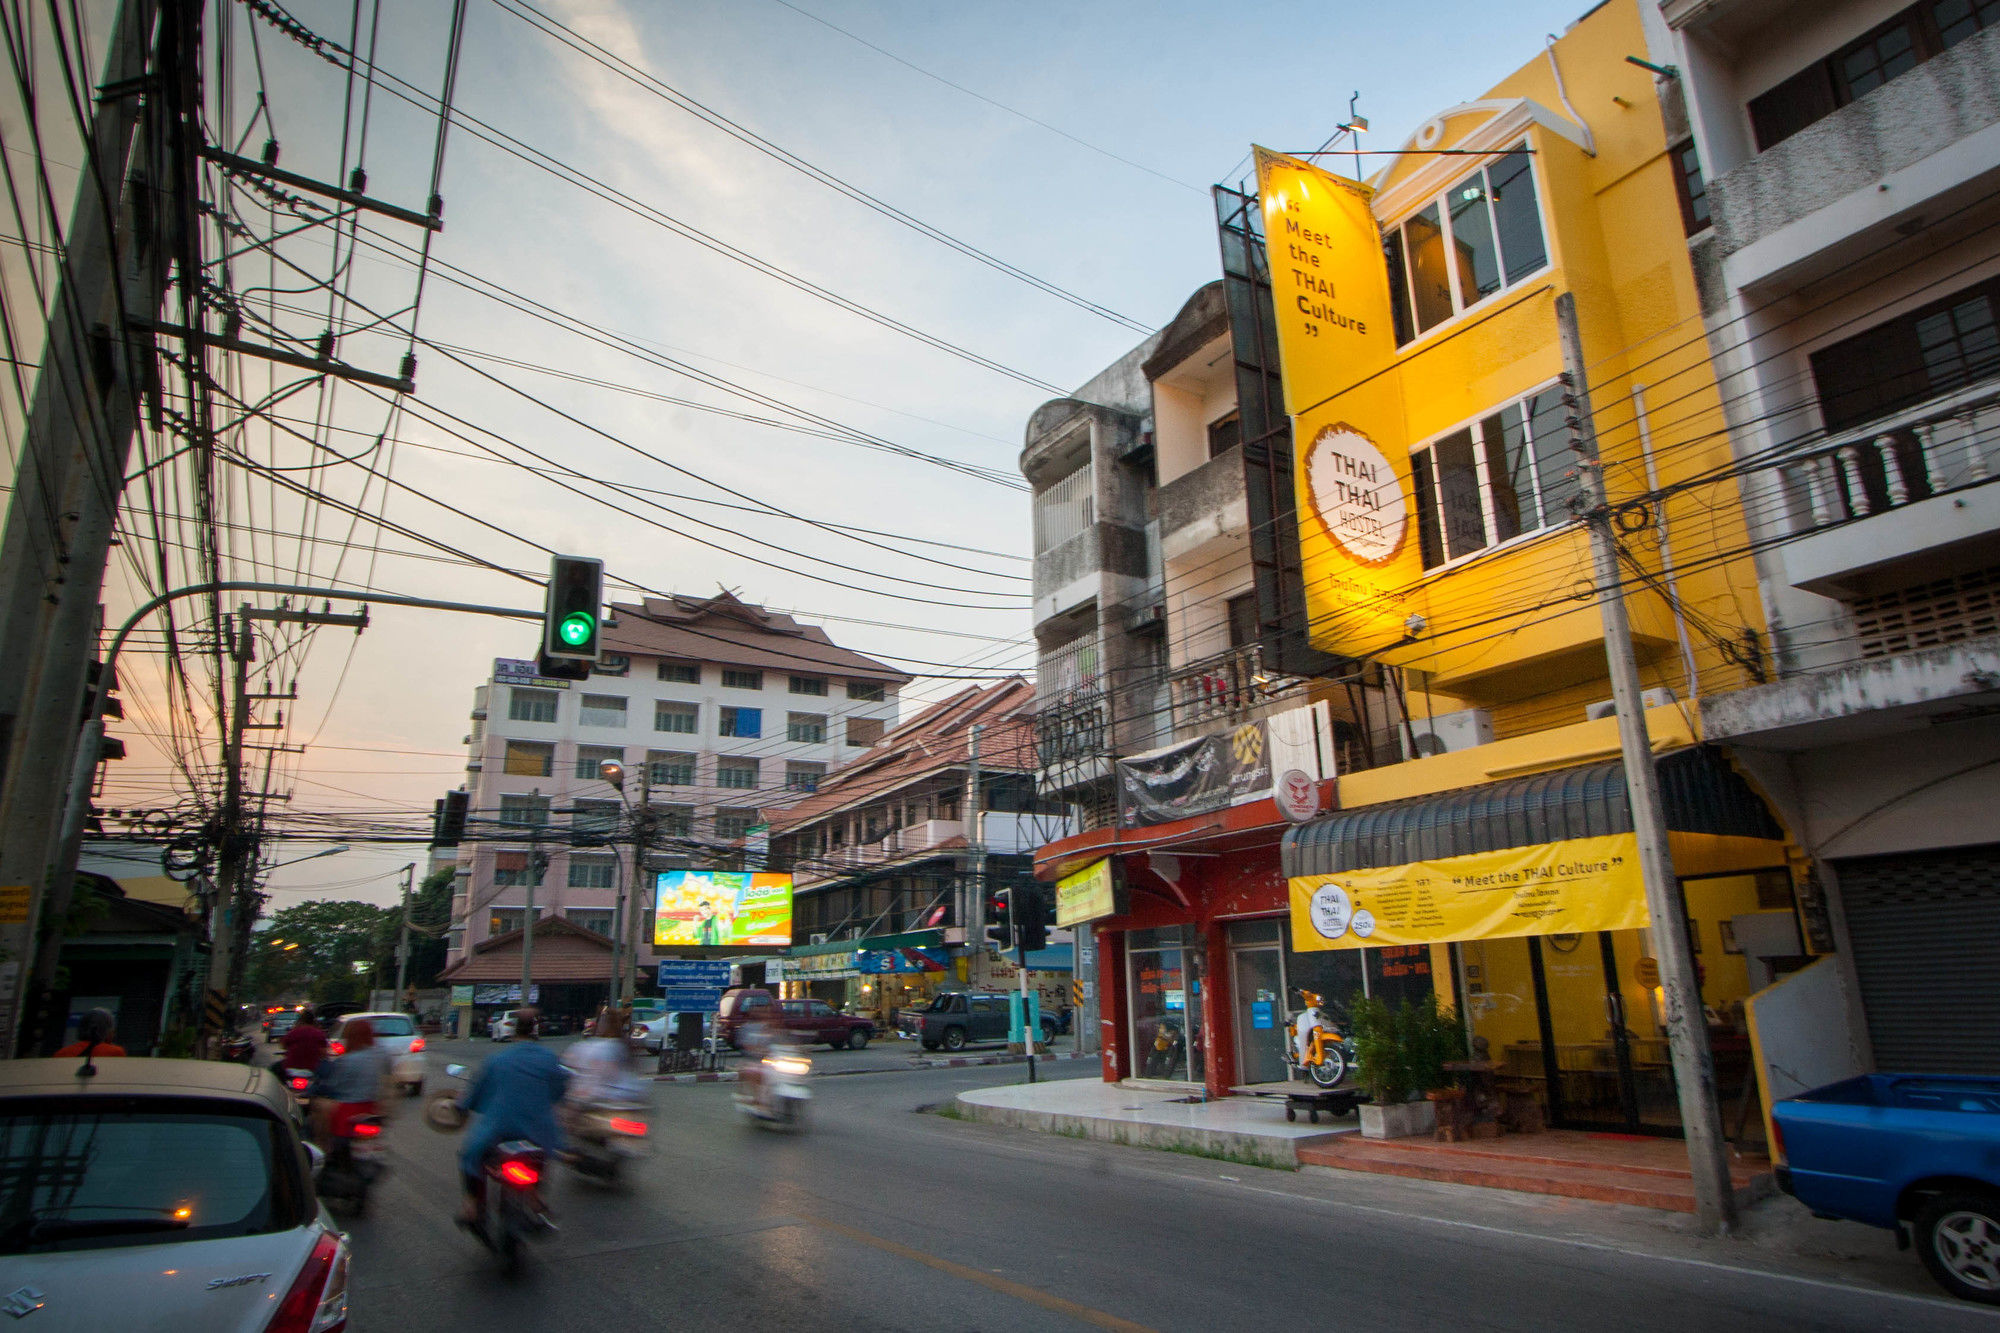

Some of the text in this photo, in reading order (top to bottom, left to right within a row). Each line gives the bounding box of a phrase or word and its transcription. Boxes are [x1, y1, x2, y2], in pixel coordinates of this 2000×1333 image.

[1285, 217, 1333, 250] Meet
[1289, 243, 1320, 268] the
[1291, 268, 1336, 299] THAI
[1297, 295, 1367, 335] Culture
[1331, 451, 1377, 484] THAI
[1334, 480, 1380, 512] THAI
[1339, 508, 1386, 540] HOSTEL
[1498, 869, 1519, 883] the
[1522, 865, 1554, 881] THAI
[1320, 894, 1341, 905] THAI
[1320, 906, 1341, 917] THAI
